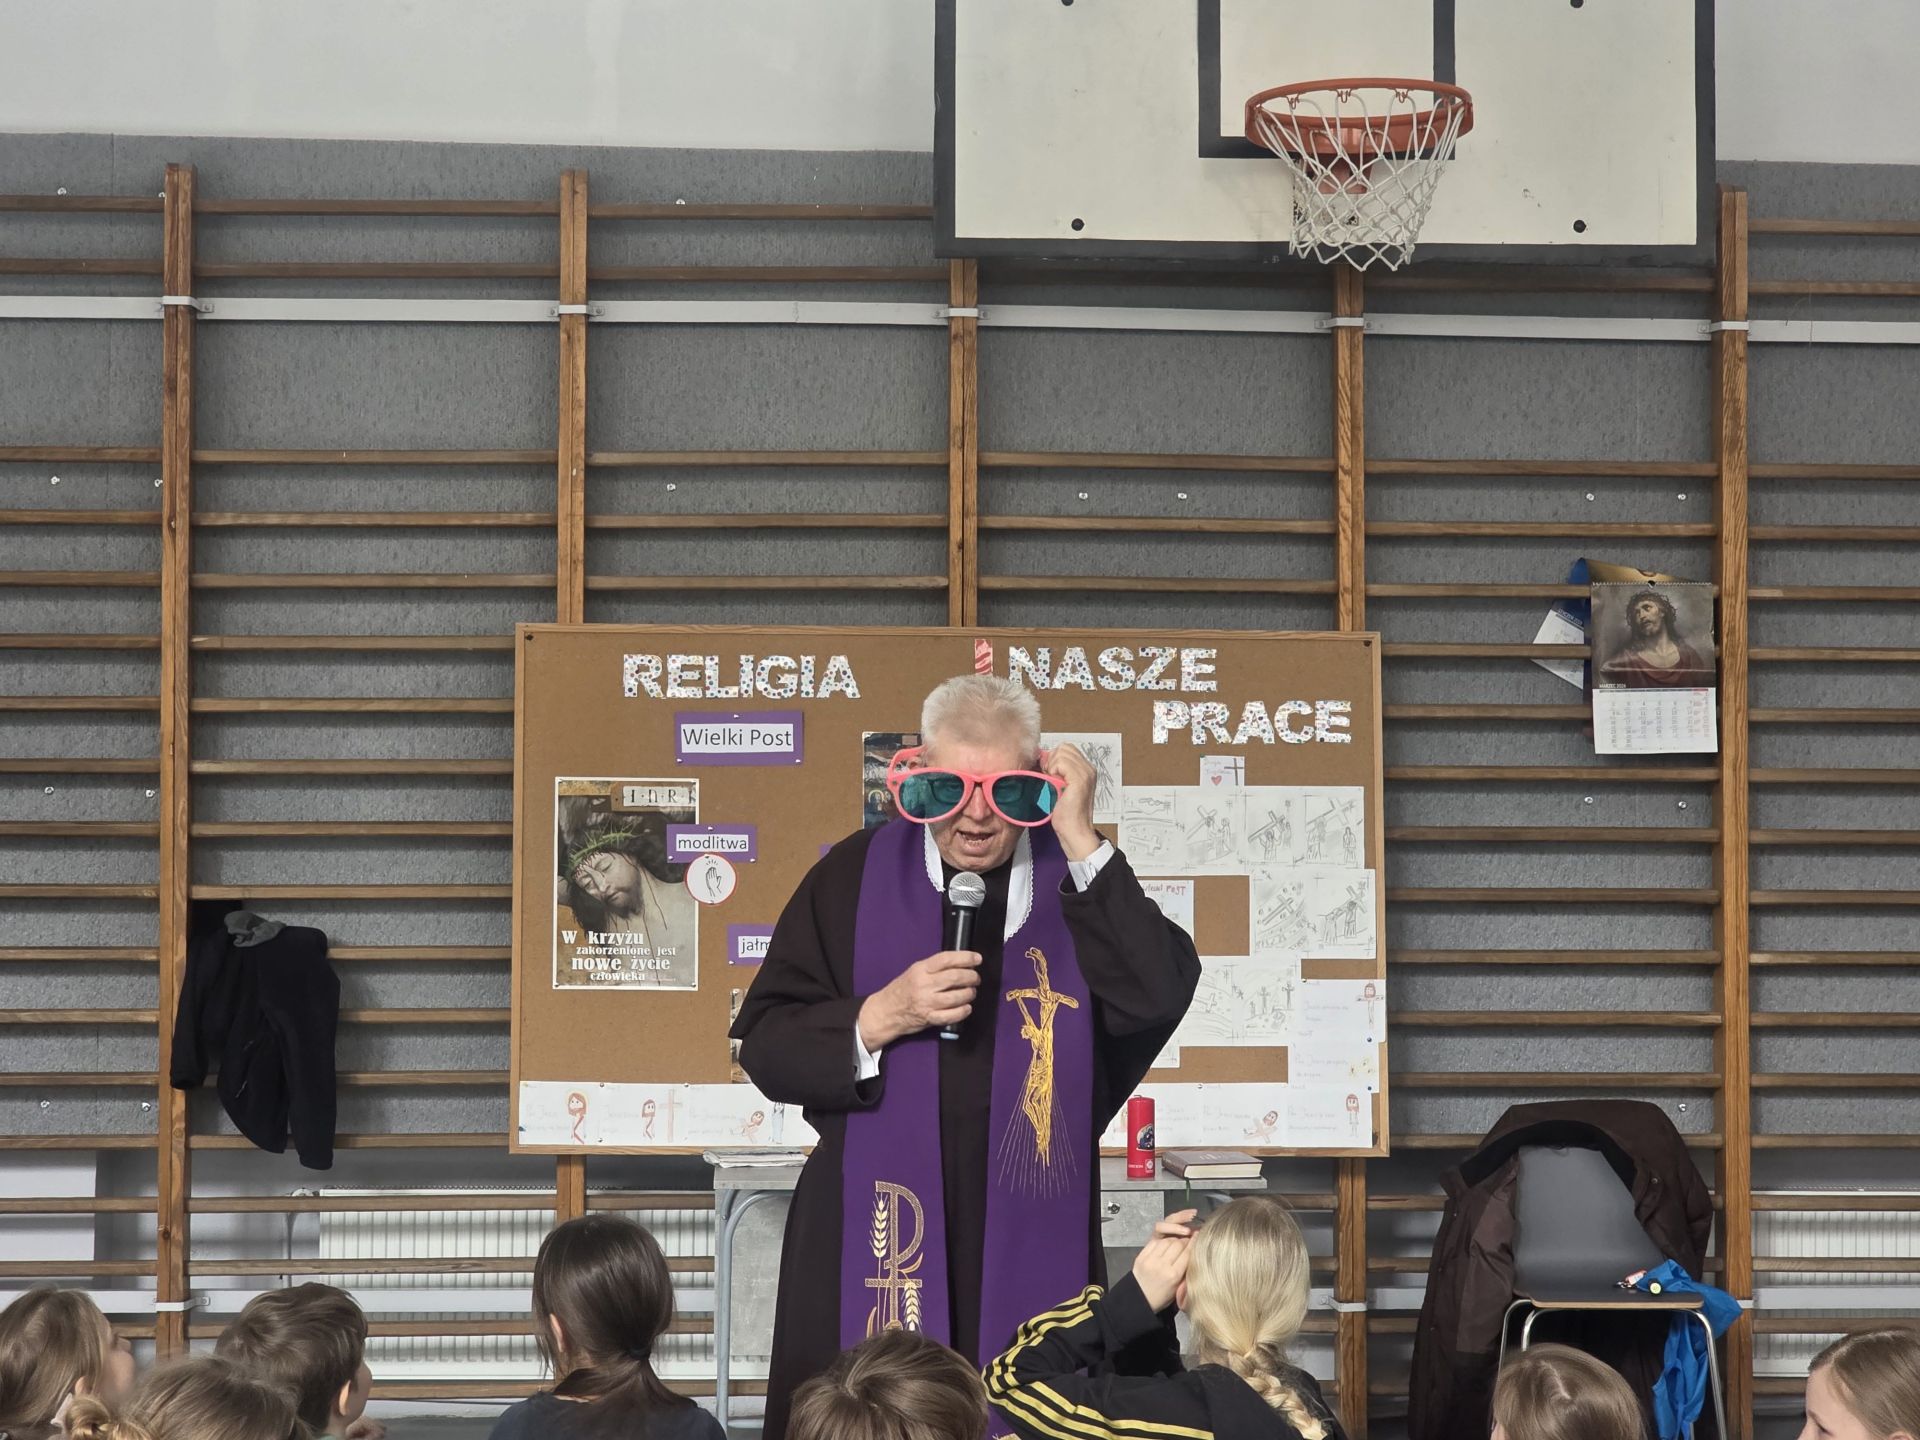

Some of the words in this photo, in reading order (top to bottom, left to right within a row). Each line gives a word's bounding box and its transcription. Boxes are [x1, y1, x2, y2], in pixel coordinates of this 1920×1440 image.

[623, 653, 861, 699] RELIGIA
[1009, 646, 1218, 692] NASZE
[1152, 700, 1352, 745] PRACE
[682, 728, 743, 746] Wielki
[750, 729, 792, 746] Post
[678, 836, 748, 850] modlitwa
[561, 930, 578, 945] W
[588, 931, 644, 946] krzyżu
[576, 945, 650, 956] zakorzenione
[657, 946, 677, 956] jest
[571, 957, 622, 971] nowe
[631, 956, 670, 971] życie
[590, 971, 646, 981] człowieka
